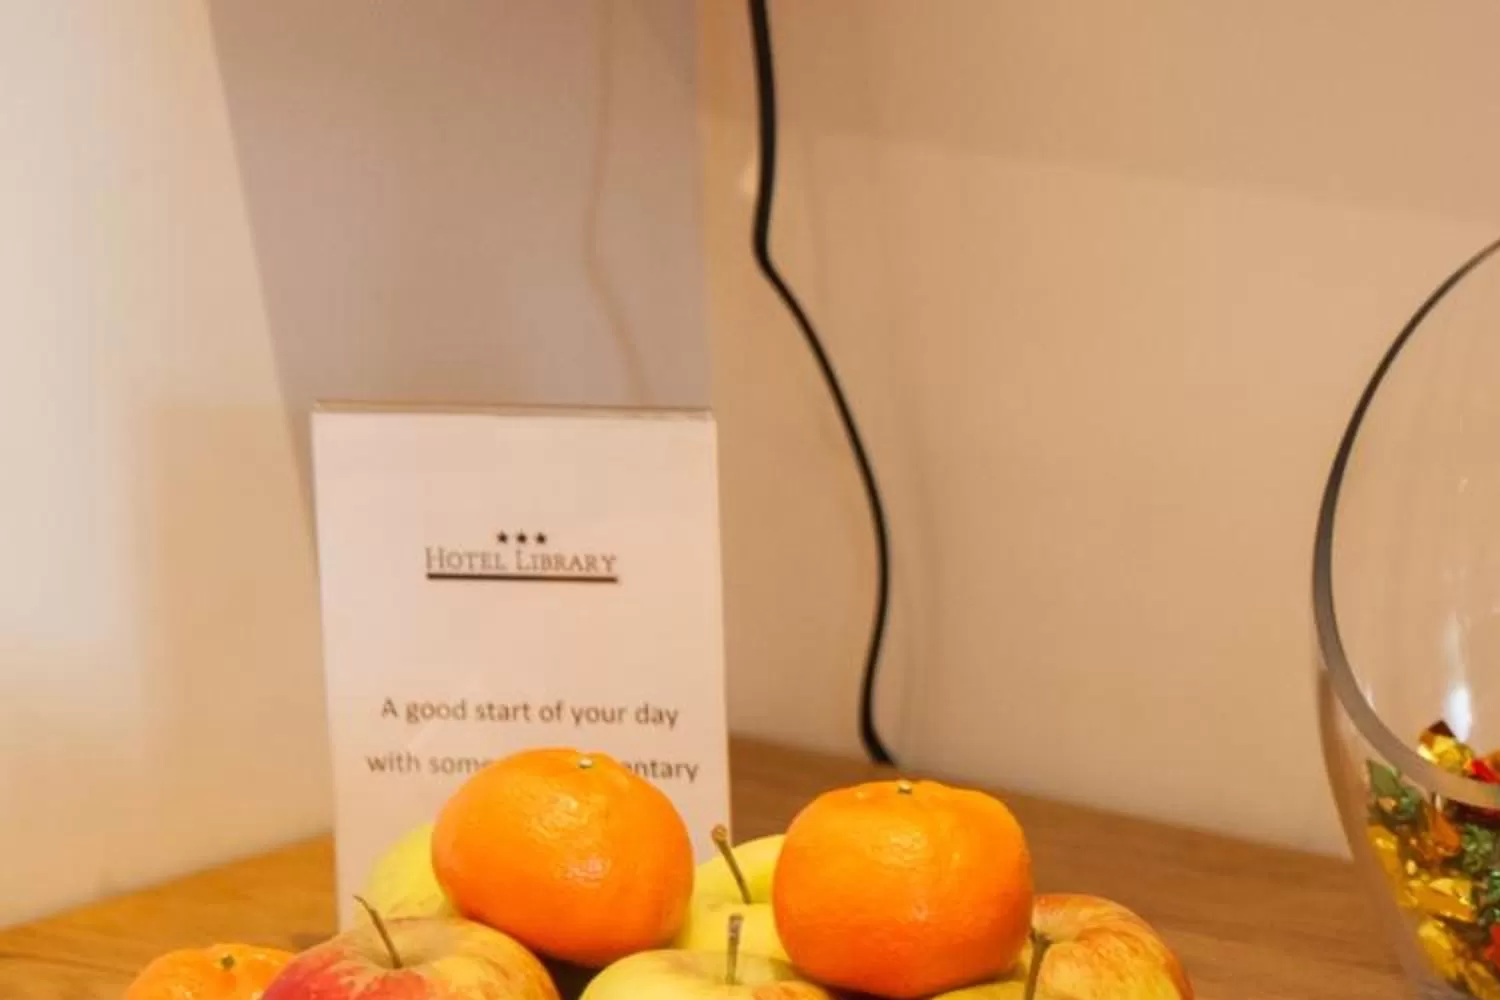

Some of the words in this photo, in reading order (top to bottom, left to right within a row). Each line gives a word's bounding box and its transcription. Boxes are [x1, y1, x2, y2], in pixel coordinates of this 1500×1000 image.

[425, 546, 508, 571] HOTEL
[515, 549, 617, 574] LIBRARY
[381, 697, 399, 719] A
[405, 699, 467, 725] good
[475, 701, 531, 721] start
[537, 700, 564, 723] of
[570, 703, 628, 728] your
[634, 702, 679, 730] day
[366, 751, 422, 774] with
